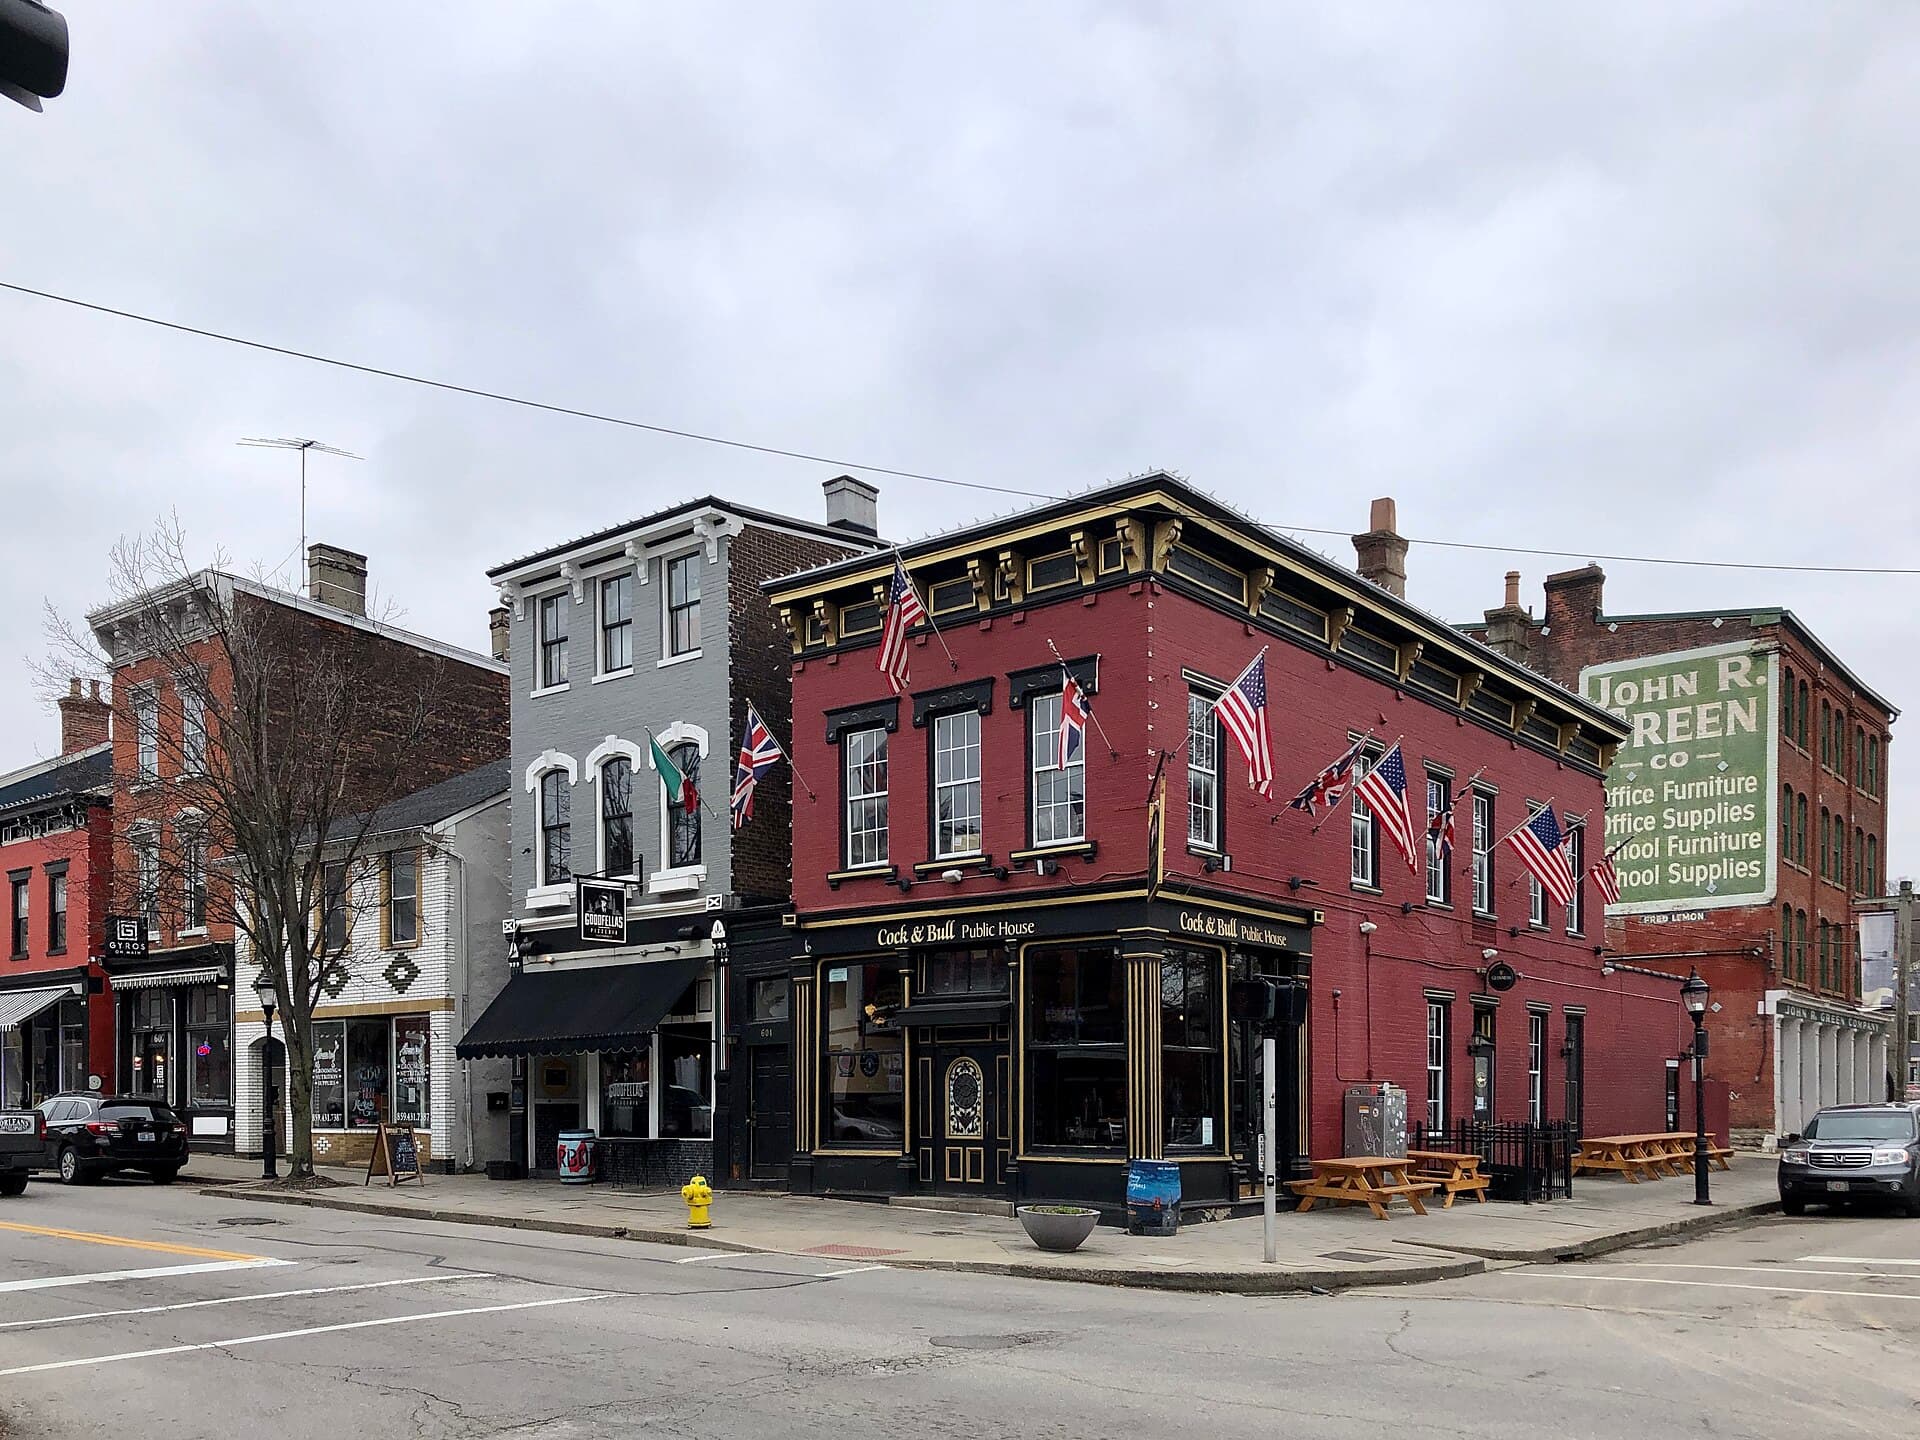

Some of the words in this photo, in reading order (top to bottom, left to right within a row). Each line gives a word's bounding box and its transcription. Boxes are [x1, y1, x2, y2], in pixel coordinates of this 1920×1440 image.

[1595, 671, 1698, 709] JOHN
[1717, 655, 1767, 692] R.
[1607, 695, 1758, 749] REEN
[1663, 775, 1758, 802] Furniture
[1662, 801, 1756, 832] Supplies
[1667, 831, 1762, 857] Furniture
[1668, 858, 1761, 887] Supplies
[584, 912, 624, 929] GOODFELLAS
[1180, 911, 1204, 933] Cock
[1205, 916, 1216, 935] &
[1217, 918, 1238, 938] Bull
[1241, 925, 1264, 943] Public
[1264, 929, 1287, 947] House
[1643, 914, 1669, 924] FRED
[1671, 912, 1704, 922] LEMON
[109, 941, 146, 950] GYROS
[877, 923, 909, 946] Cock
[911, 925, 925, 944] &
[926, 919, 956, 942] Bull
[961, 921, 995, 939] Public
[998, 921, 1035, 937] House
[1784, 1005, 1807, 1018] JOHN
[1820, 1012, 1845, 1026] GREEN
[1848, 1018, 1880, 1033] COMPANY
[608, 1083, 644, 1098] GOODFELLAS
